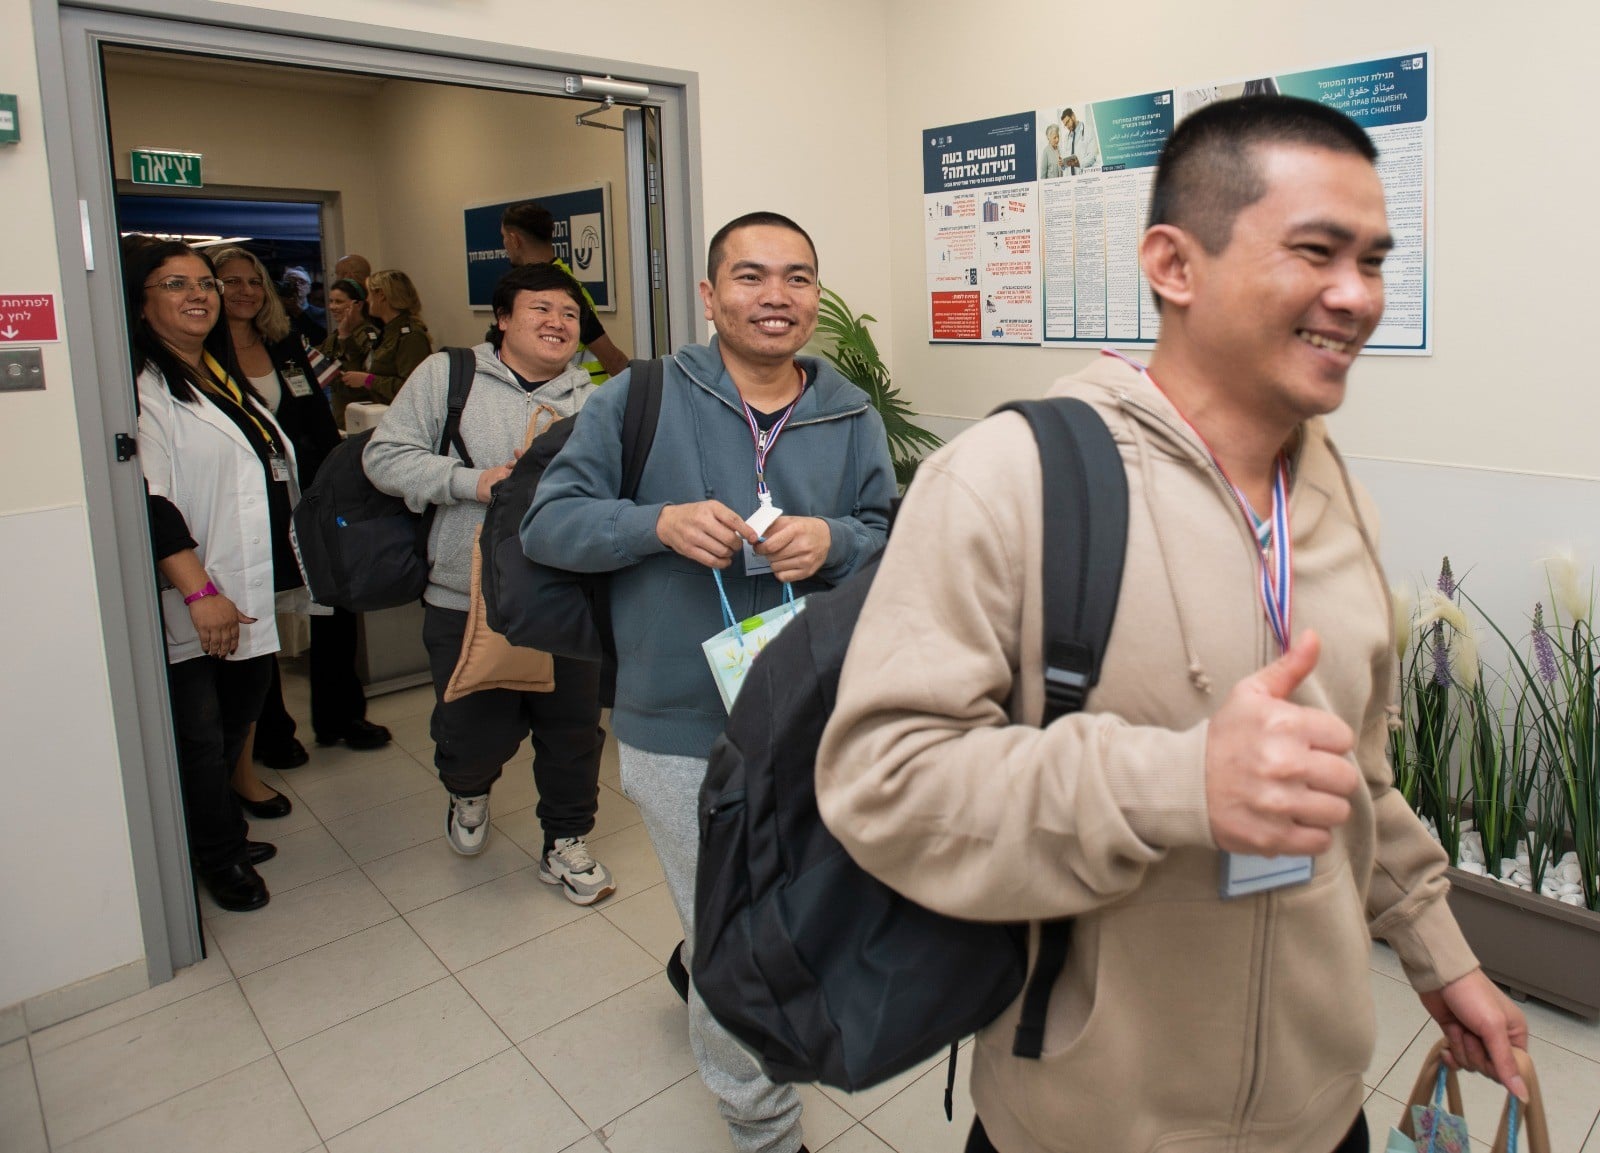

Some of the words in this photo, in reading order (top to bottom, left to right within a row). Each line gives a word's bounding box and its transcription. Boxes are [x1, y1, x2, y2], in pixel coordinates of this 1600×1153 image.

[1347, 75, 1369, 85] זכויות
[1371, 71, 1395, 81] מגילת
[1318, 78, 1346, 88] המטופל
[1347, 86, 1370, 98] حقوق
[1351, 97, 1370, 106] ПРАВ
[1370, 93, 1408, 104] ПАЦИЕНТА
[1370, 104, 1401, 115] CHARTER
[966, 146, 998, 161] עושים
[1000, 143, 1016, 156] מה
[941, 151, 963, 164] בעת
[140, 154, 192, 184] יציאה
[941, 163, 980, 180] אדמה?
[980, 158, 1016, 174] רעידת
[2, 297, 49, 307] לפתיחת
[7, 310, 31, 323] לחץ
